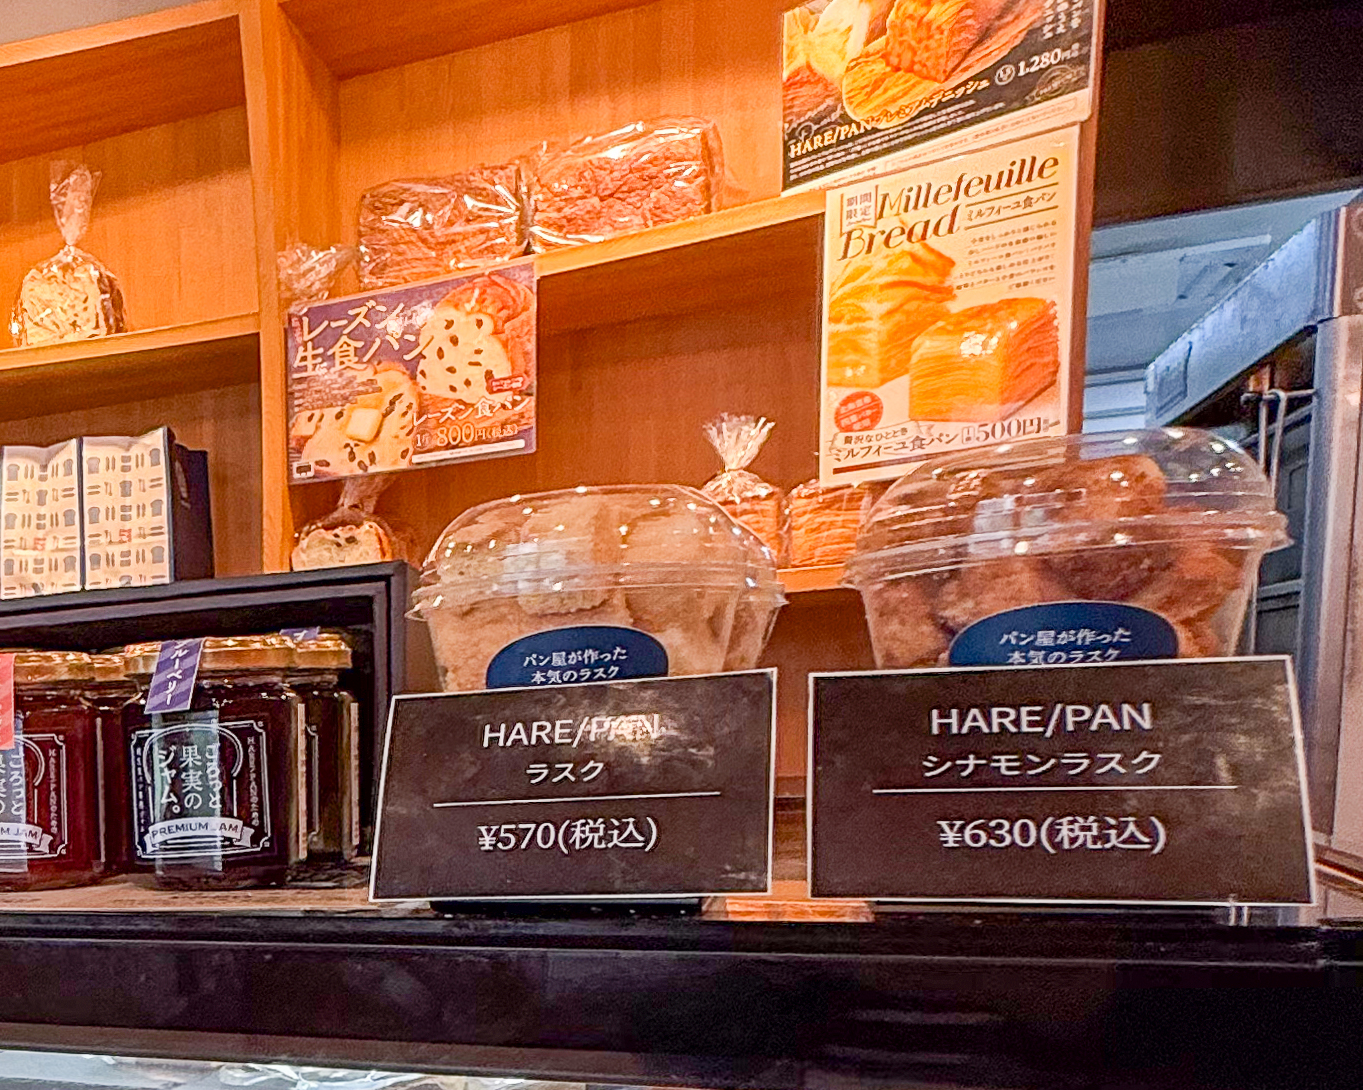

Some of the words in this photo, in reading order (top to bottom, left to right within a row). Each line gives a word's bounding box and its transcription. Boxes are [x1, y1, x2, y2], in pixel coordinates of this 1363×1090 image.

[877, 155, 1059, 221] Millefeuille
[837, 204, 962, 262] Bread
[302, 300, 406, 343] レーズン
[291, 333, 436, 379] 生食パン
[413, 396, 530, 427] レーズン食パン
[834, 432, 959, 462] ミルフィーユ食パン
[999, 627, 1132, 648] パン屋が作った
[522, 645, 629, 669] パン屋が作った
[1006, 648, 1122, 665] 本気のラスク
[530, 665, 620, 685] 本気のラスク
[482, 713, 663, 749] HARE/PAN
[929, 702, 1153, 738] HARE/PAN
[158, 745, 181, 814] ジャム。
[180, 744, 203, 810] 果実の
[525, 759, 606, 785] ラスク
[921, 750, 1163, 779] シナモンラスク
[14, 827, 38, 840] JM
[151, 822, 209, 838] PREMIUM
[477, 816, 659, 855] ¥570(税込)
[936, 815, 1168, 855] ¥630(税込)
